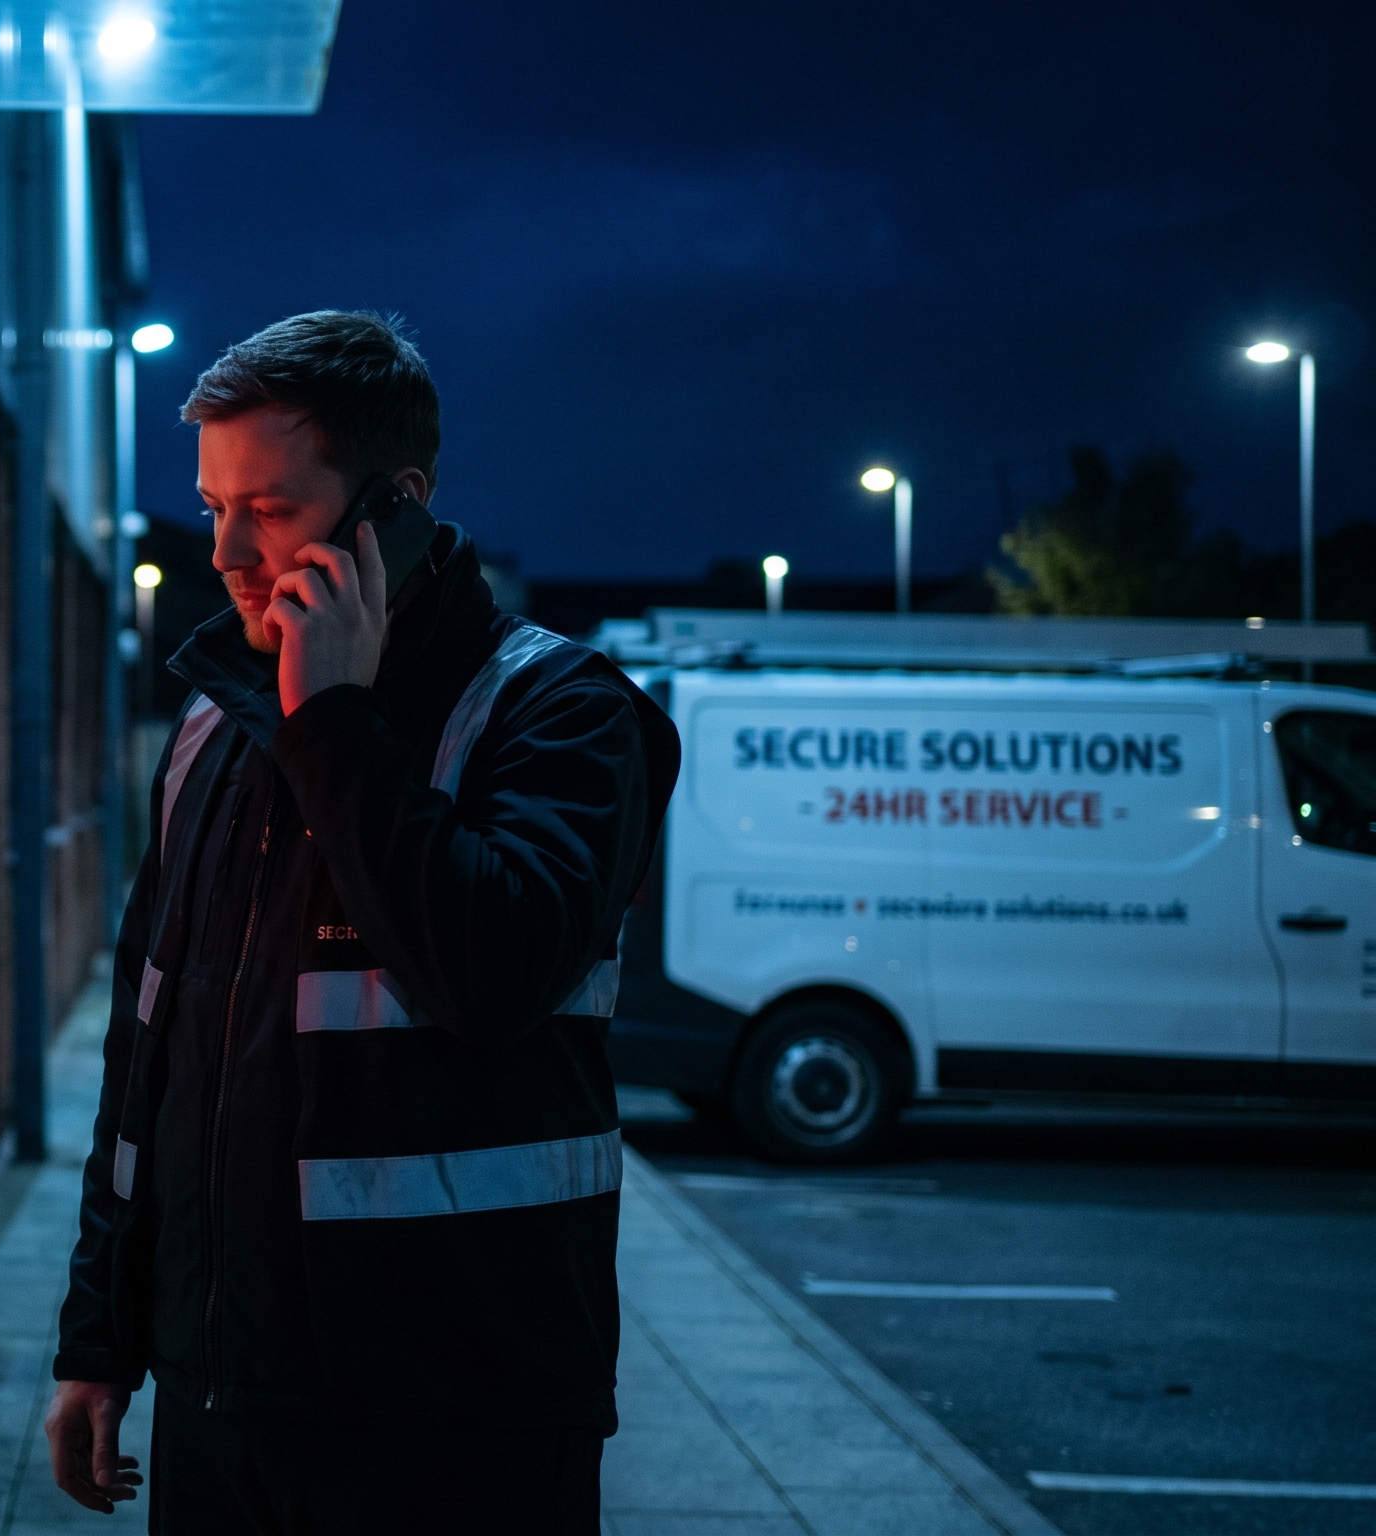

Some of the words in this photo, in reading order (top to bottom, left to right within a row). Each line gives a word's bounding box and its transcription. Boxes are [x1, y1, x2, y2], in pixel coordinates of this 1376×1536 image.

[734, 727, 908, 773] SECURE
[920, 730, 1183, 776] SOLUTIONS
[825, 787, 928, 827] 24HR
[939, 788, 1103, 829] SERVICE
